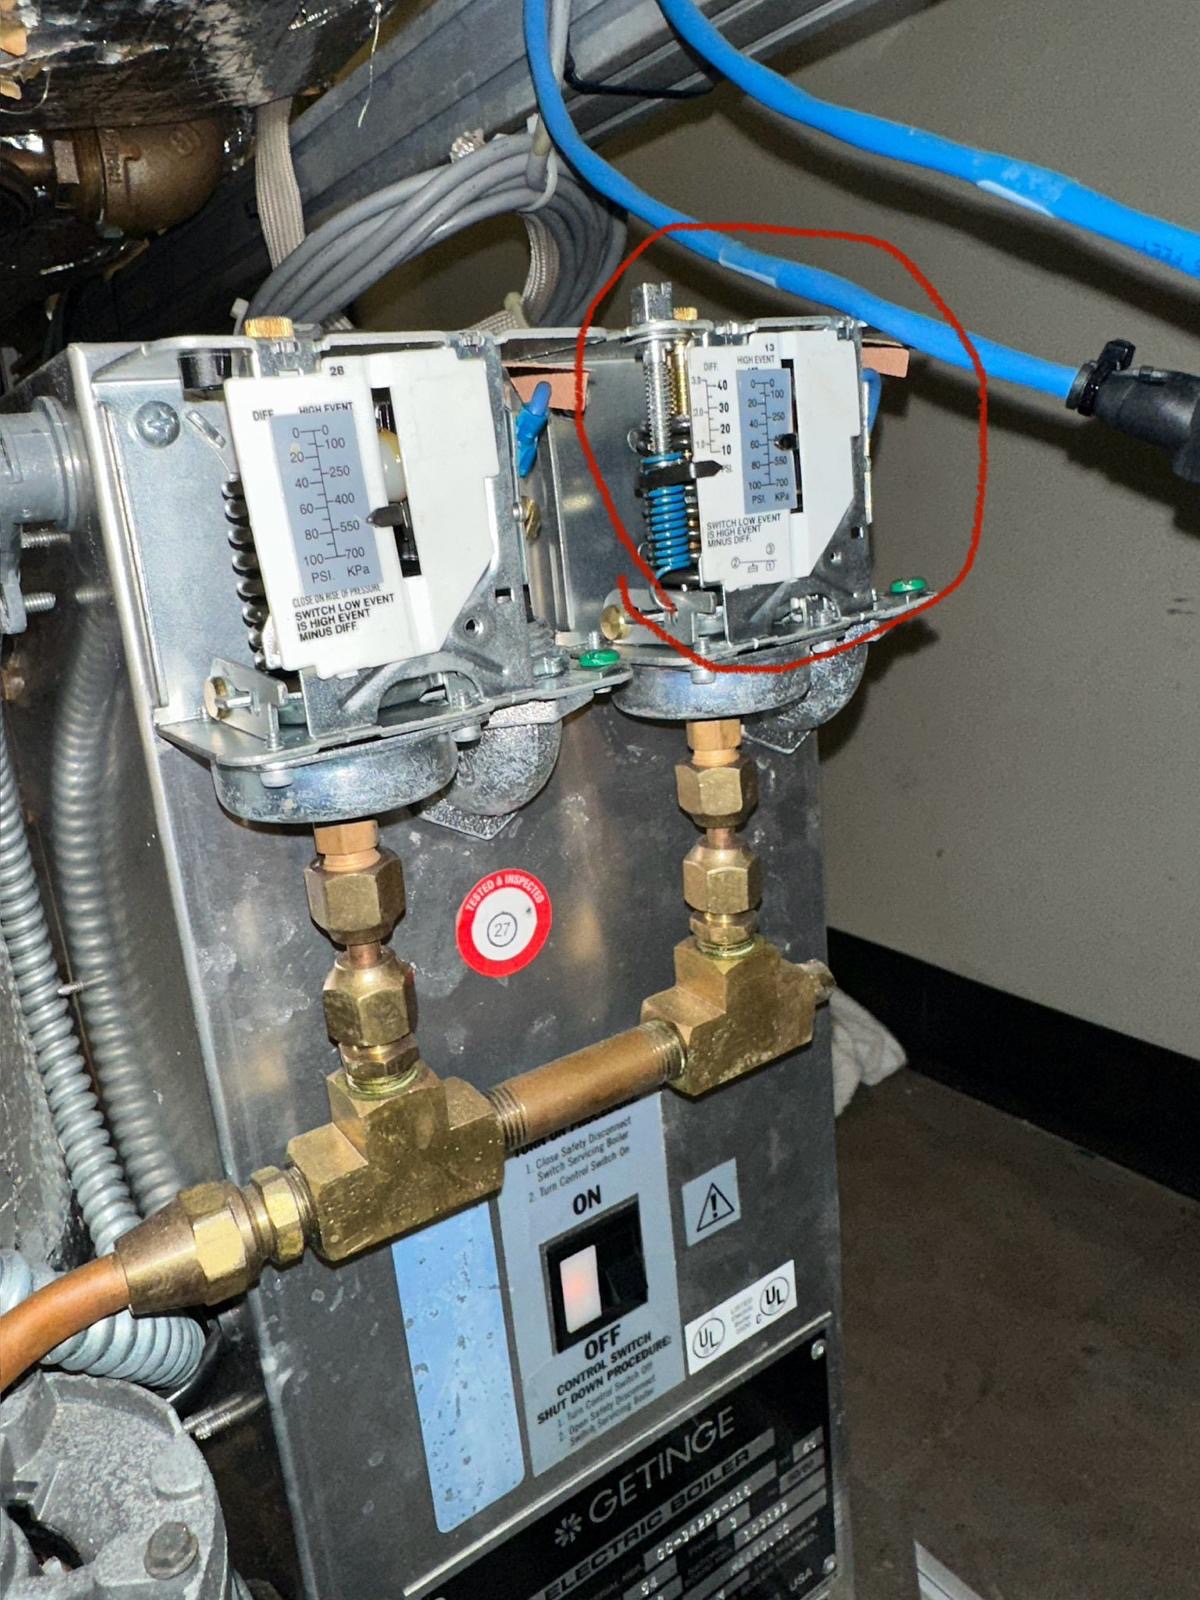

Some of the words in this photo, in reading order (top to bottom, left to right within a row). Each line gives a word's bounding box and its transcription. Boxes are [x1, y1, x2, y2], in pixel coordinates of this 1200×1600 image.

[765, 343, 775, 352] 13
[737, 356, 753, 364] HIGH
[754, 355, 775, 363] EVENT
[717, 380, 728, 390] 40
[750, 380, 756, 389] 0
[769, 378, 775, 387] 0
[770, 390, 784, 399] 100
[719, 403, 729, 413] 30
[748, 399, 757, 408] 20
[772, 412, 785, 421] 250
[321, 424, 329, 435] 0
[720, 424, 731, 434] 20
[749, 420, 759, 428] 40
[291, 427, 300, 439] 0
[325, 437, 346, 449] 100
[750, 440, 759, 449] 60
[722, 445, 731, 455] 10
[289, 451, 305, 463] 20
[775, 456, 787, 466] 550
[329, 465, 350, 478] 250
[751, 461, 761, 470] 80
[295, 477, 309, 489] 40
[749, 481, 761, 490] 100
[775, 478, 789, 487] 700
[335, 492, 355, 504] 400
[775, 492, 790, 502] KPa
[300, 503, 314, 515] 60
[340, 520, 360, 533] 550
[707, 519, 737, 530] SWITCH
[738, 516, 756, 526] LOW
[758, 513, 781, 524] EVENT
[305, 528, 319, 541] 80
[707, 530, 715, 539] IS
[716, 527, 736, 537] HIGH
[737, 524, 762, 535] EVENT
[708, 538, 733, 548] MINUS
[345, 546, 365, 559] 700
[304, 553, 325, 567] 100
[347, 564, 370, 577] KPa
[292, 594, 314, 608] CLOSE
[315, 593, 325, 603] ON
[325, 590, 342, 602] RISE
[295, 604, 336, 621] SWITCH
[338, 599, 361, 612] LOW
[363, 593, 395, 607] EVENT
[297, 621, 308, 632] IS
[310, 615, 336, 629] HIGH
[339, 608, 371, 622] EVENT
[299, 627, 333, 642] MINUS
[465, 880, 495, 912] TESTED
[504, 874, 545, 904] INSPECTED
[494, 922, 511, 938] 27
[536, 1153, 559, 1169] Close
[561, 1140, 587, 1157] Safety
[588, 1116, 632, 1143] Disconnect
[537, 1163, 566, 1182] Switch
[568, 1143, 604, 1167] Servicing
[607, 1131, 629, 1148] Boiler
[539, 1183, 558, 1198] Turn
[560, 1165, 589, 1187] Control
[590, 1152, 617, 1171] Switch
[619, 1146, 630, 1157] On
[572, 1184, 602, 1215] ON
[766, 1286, 786, 1305] UL
[584, 1323, 621, 1361] OFF
[699, 1328, 719, 1348] UL
[557, 1359, 607, 1396] CONTROL
[610, 1331, 652, 1364] SWITCH
[537, 1398, 570, 1425] SHUT
[571, 1377, 603, 1404] DOWN
[607, 1334, 672, 1381] PROCEDURE:
[585, 1388, 613, 1409] Control
[615, 1371, 640, 1390] Switch
[569, 1416, 588, 1436] Open
[590, 1399, 613, 1421] Safety
[597, 1403, 632, 1428] Servicing
[589, 1405, 735, 1524] GETINGE
[544, 1510, 664, 1600] ELECTRIC
[670, 1448, 750, 1512] BOILER
[789, 1567, 813, 1591] USA
